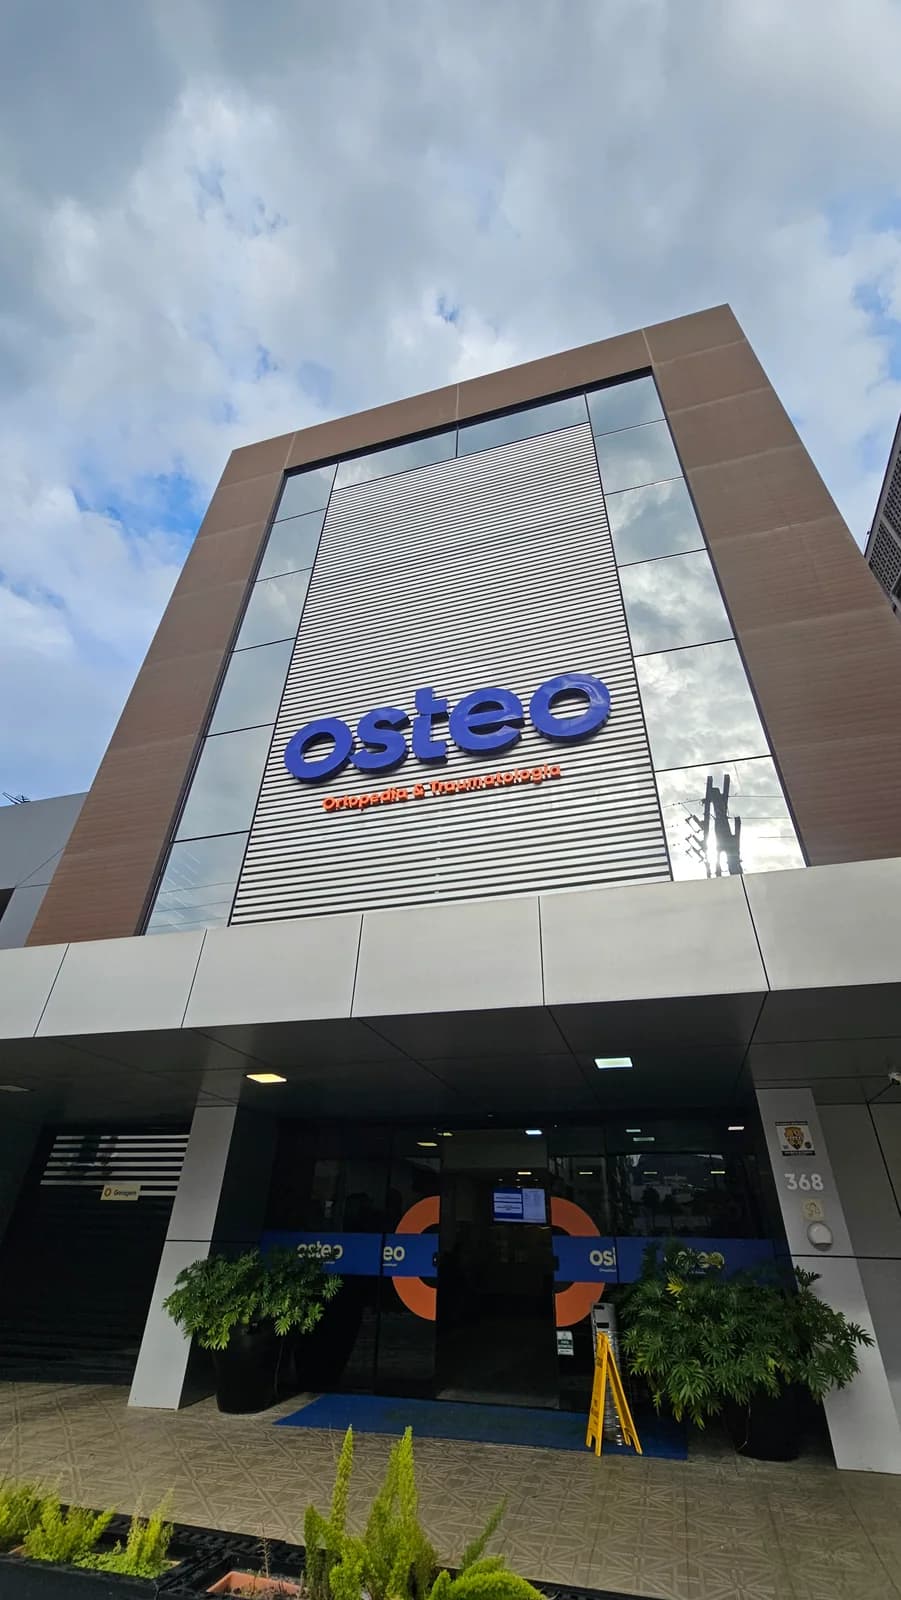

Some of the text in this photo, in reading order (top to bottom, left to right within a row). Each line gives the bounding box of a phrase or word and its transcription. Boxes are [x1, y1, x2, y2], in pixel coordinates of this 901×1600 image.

[284, 673, 611, 783] osteo
[322, 789, 408, 812] Ortopedia
[413, 783, 425, 799] &
[784, 1174, 824, 1190] 368
